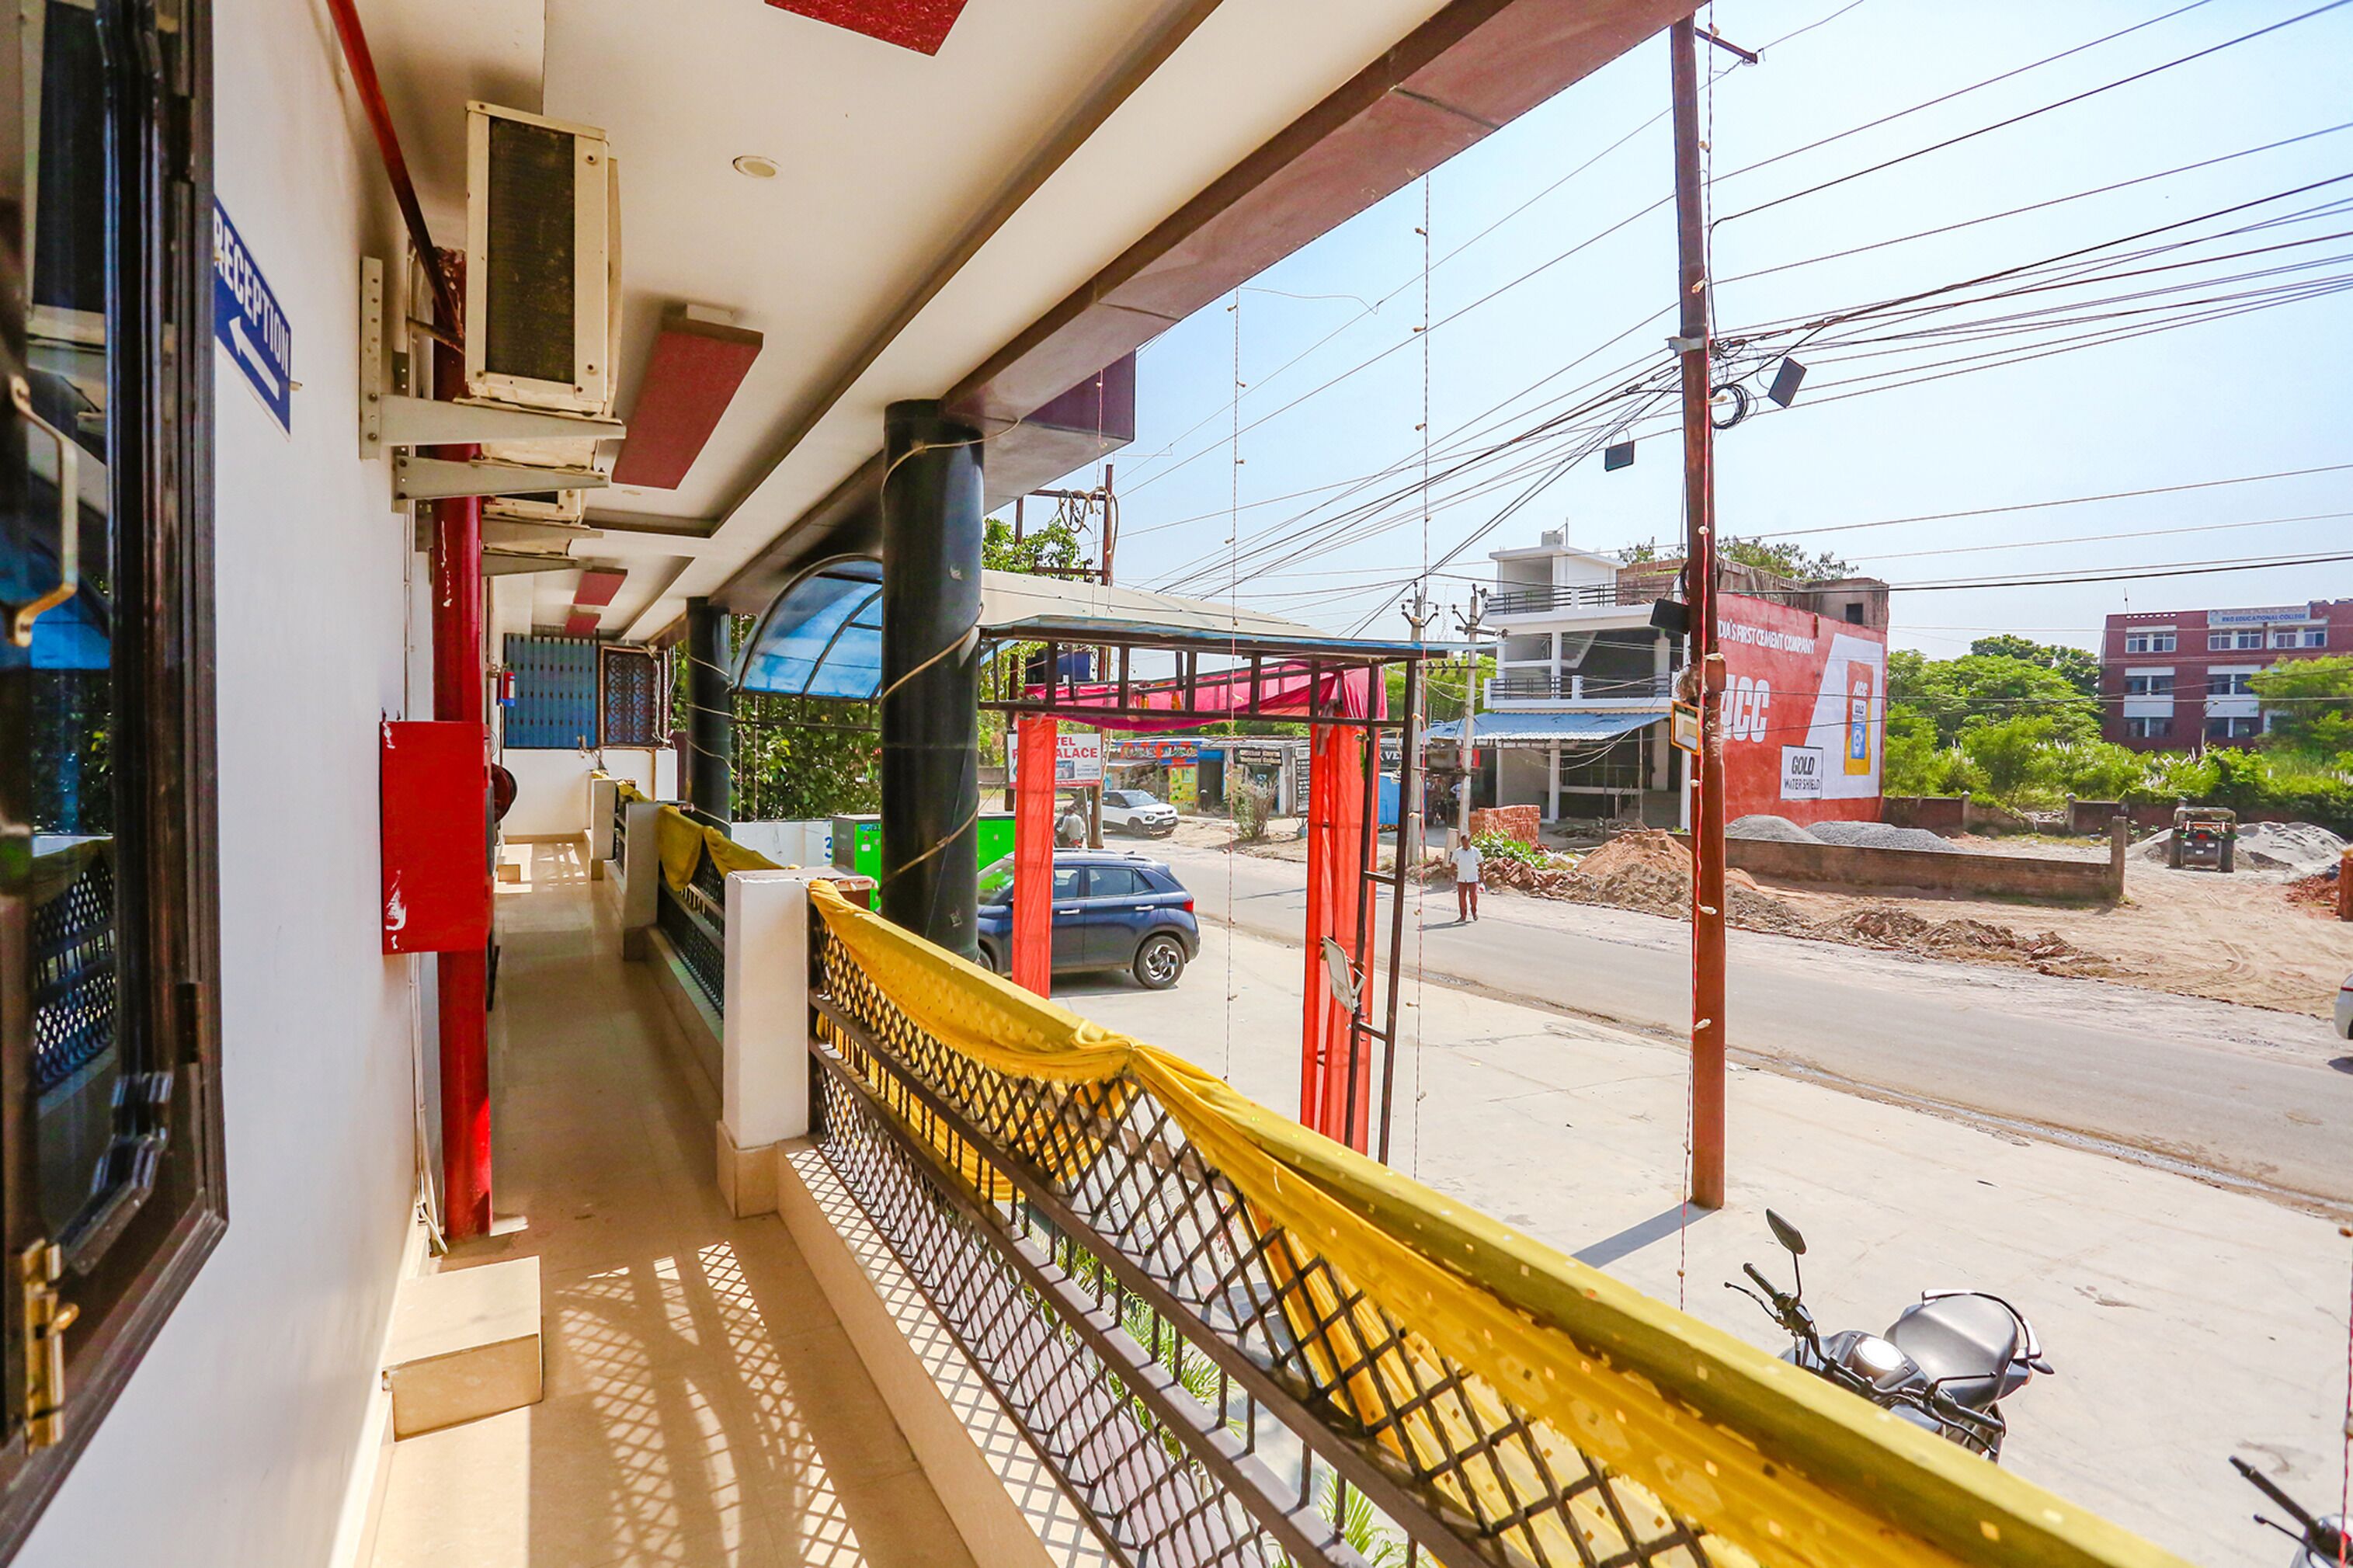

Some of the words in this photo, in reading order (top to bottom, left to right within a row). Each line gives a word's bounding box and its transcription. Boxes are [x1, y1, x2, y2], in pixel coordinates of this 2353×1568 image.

[214, 206, 290, 378] RECEPTION
[1717, 618, 1736, 641] DIA'S
[1736, 624, 1756, 645] FIRST
[1756, 628, 1784, 651] CEMENT
[1785, 635, 1816, 654] COMPANY
[1720, 673, 1770, 743] ACC
[1056, 736, 1076, 746] TEL
[1056, 747, 1098, 759] ALACE
[1792, 756, 1815, 775] GOLD
